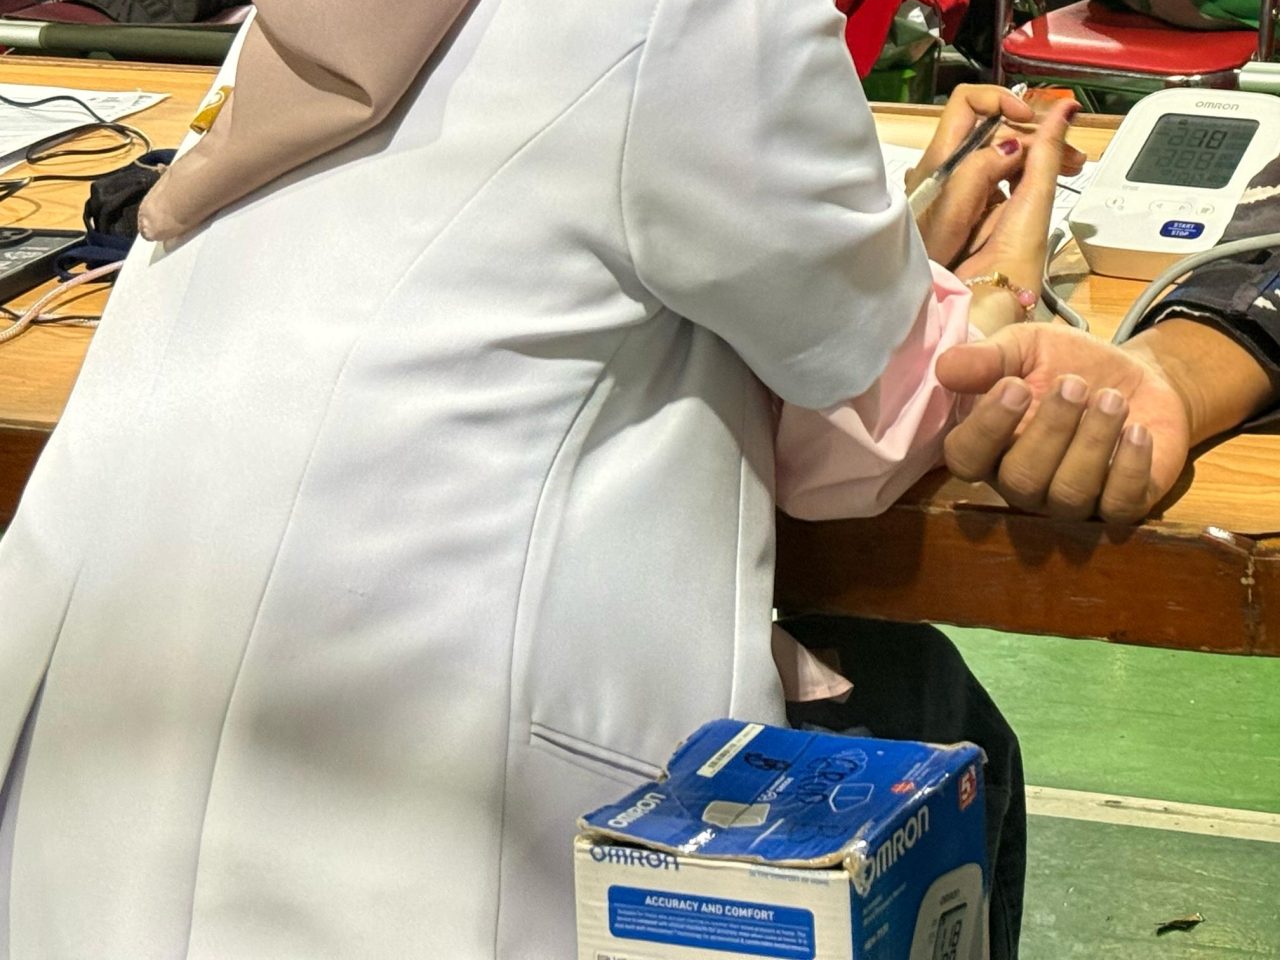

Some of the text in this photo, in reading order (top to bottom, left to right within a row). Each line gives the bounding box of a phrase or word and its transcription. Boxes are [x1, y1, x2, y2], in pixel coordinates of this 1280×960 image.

[1195, 100, 1240, 112] OMRON
[1171, 229, 1190, 237] STOP
[1173, 222, 1195, 230] START
[608, 792, 667, 828] OMRON
[589, 845, 680, 871] OMRON
[862, 804, 930, 897] OMRON
[645, 895, 775, 921] ACCURACY AND COMFORT
